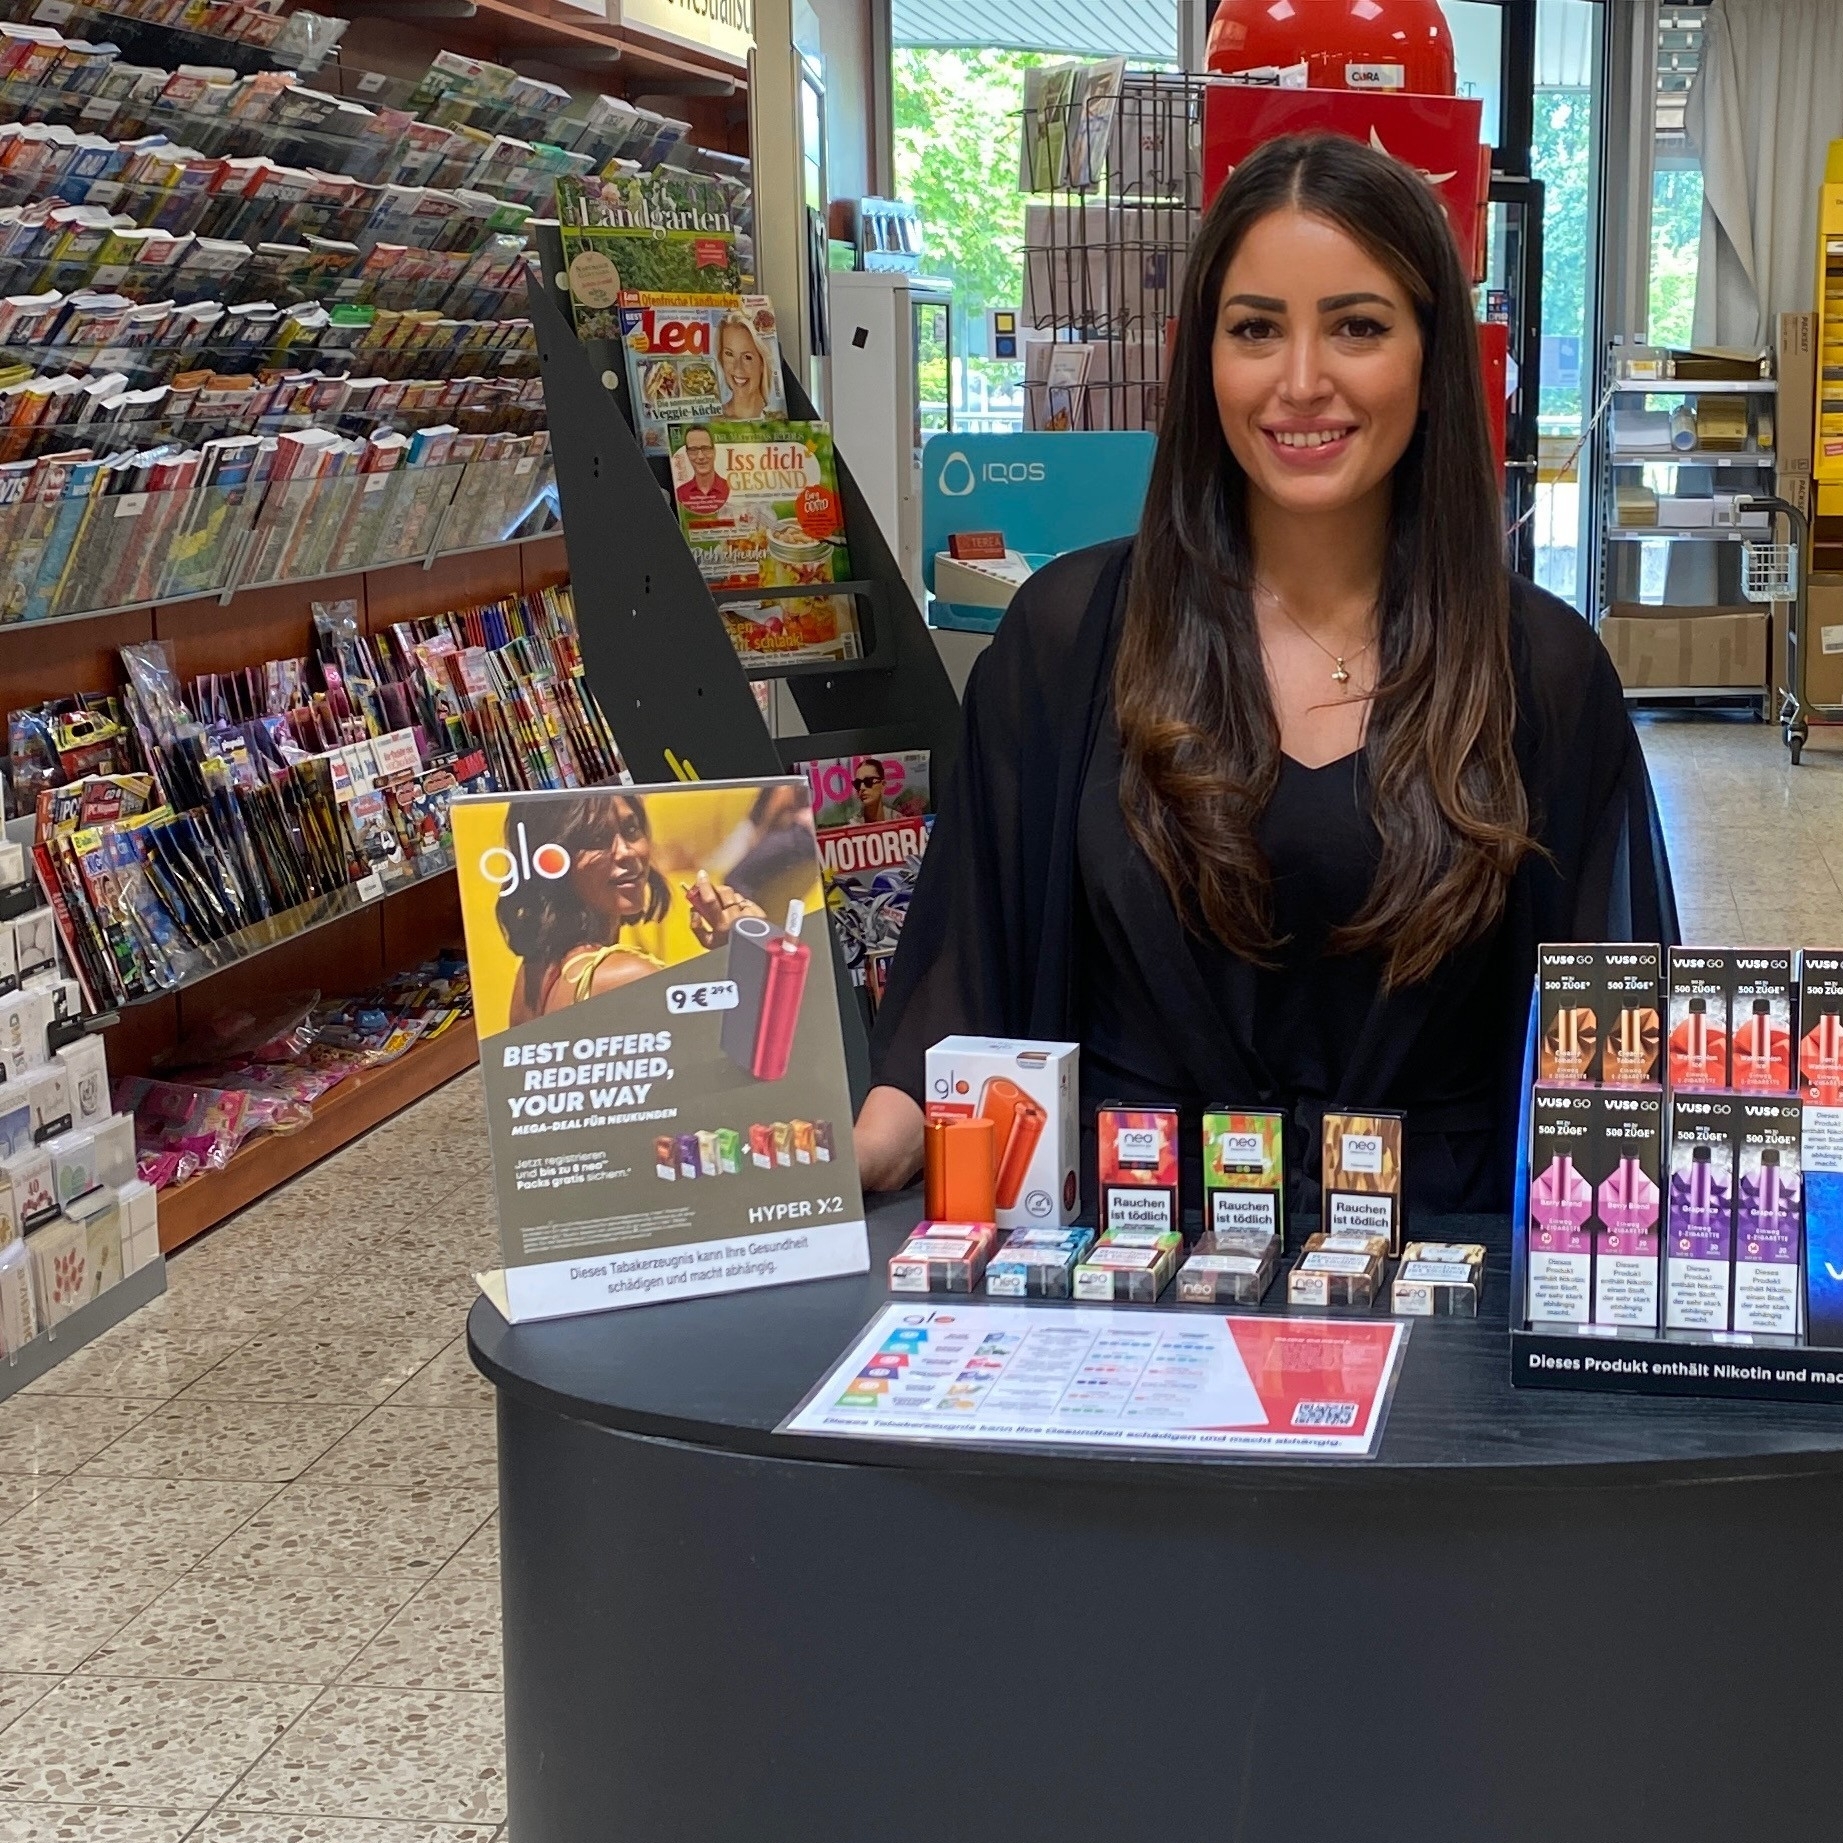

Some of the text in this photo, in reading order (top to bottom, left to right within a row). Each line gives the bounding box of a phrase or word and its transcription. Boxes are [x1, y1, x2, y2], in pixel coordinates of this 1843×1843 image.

[642, 310, 710, 355] Lea
[726, 446, 804, 471] Iss dich
[982, 463, 1045, 484] IQOS
[727, 471, 807, 491] GESUND
[479, 822, 570, 897] glo
[1577, 955, 1593, 965] GO
[1639, 955, 1656, 965] GO
[1707, 959, 1724, 968] GO
[1771, 960, 1788, 969] GO
[1675, 985, 1691, 993] 500
[1738, 986, 1754, 994] 500
[1807, 987, 1823, 995] 500
[672, 990, 687, 1009] 9
[503, 1031, 672, 1067] BEST OFFERS
[524, 1058, 674, 1091] REDEFINED,
[934, 1070, 969, 1099] glo
[508, 1083, 652, 1118] YOUR WAY
[1573, 1098, 1591, 1108] GO
[1640, 1100, 1659, 1111] GO
[1713, 1104, 1731, 1114] GO
[1781, 1107, 1799, 1117] GO
[511, 1108, 678, 1136] MEGA-DEAL FÜR NEUKUNDEN
[1539, 1126, 1555, 1134] 500
[1606, 1128, 1622, 1137] 500
[1677, 1131, 1695, 1140] 500
[1124, 1134, 1152, 1144] neo
[1228, 1137, 1257, 1148] neo
[1746, 1134, 1763, 1143] 500
[1348, 1140, 1376, 1151] neo
[545, 1151, 607, 1167] registrieren
[516, 1168, 538, 1179] und
[539, 1167, 556, 1176] bis
[558, 1166, 571, 1175] zu
[516, 1179, 550, 1190] Packs
[552, 1174, 585, 1188] gratis
[1113, 1197, 1165, 1209] Rauchen
[1219, 1201, 1270, 1212] Rauchen
[1336, 1202, 1386, 1214] Rauchen
[748, 1196, 843, 1224] HYPER X2
[1111, 1210, 1168, 1221] ist tödlich
[1216, 1214, 1273, 1225] ist tödlich
[1333, 1214, 1388, 1227] ist tödlich
[570, 1236, 808, 1280] Dieses Tabakerzeugnis kann Ihre Gesundheit
[608, 1259, 776, 1293] schädigen und macht abhängig.
[1183, 1283, 1212, 1295] neo
[1529, 1354, 1580, 1371] Dieses
[1585, 1356, 1648, 1374] Produkt
[1652, 1360, 1710, 1377] enthält
[1713, 1365, 1771, 1380] Nikotin
[1775, 1368, 1807, 1382] und
